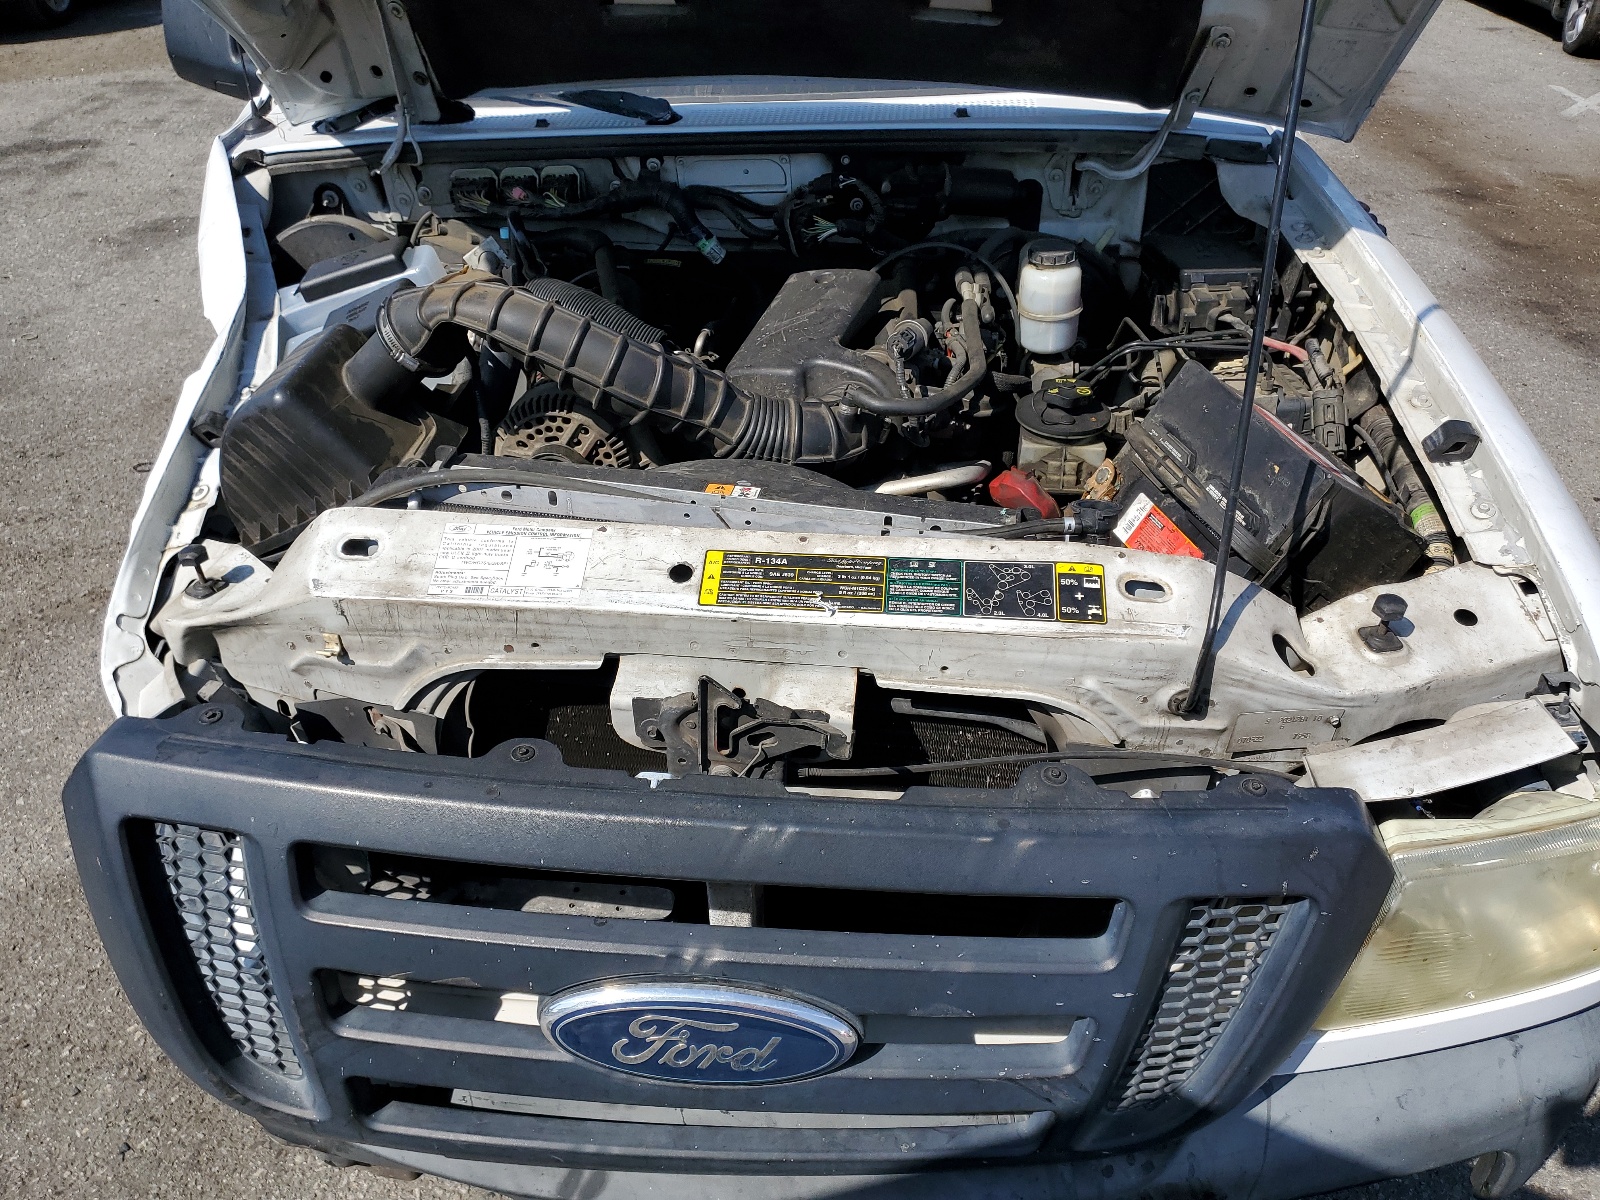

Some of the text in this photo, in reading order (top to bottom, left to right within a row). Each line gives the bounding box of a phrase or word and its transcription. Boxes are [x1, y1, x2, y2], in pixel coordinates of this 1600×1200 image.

[754, 557, 788, 565] R-134A
[1060, 578, 1079, 586] 50%
[490, 588, 524, 596] CATALYST
[1061, 606, 1080, 614] 50%
[611, 1014, 783, 1072] Ford
